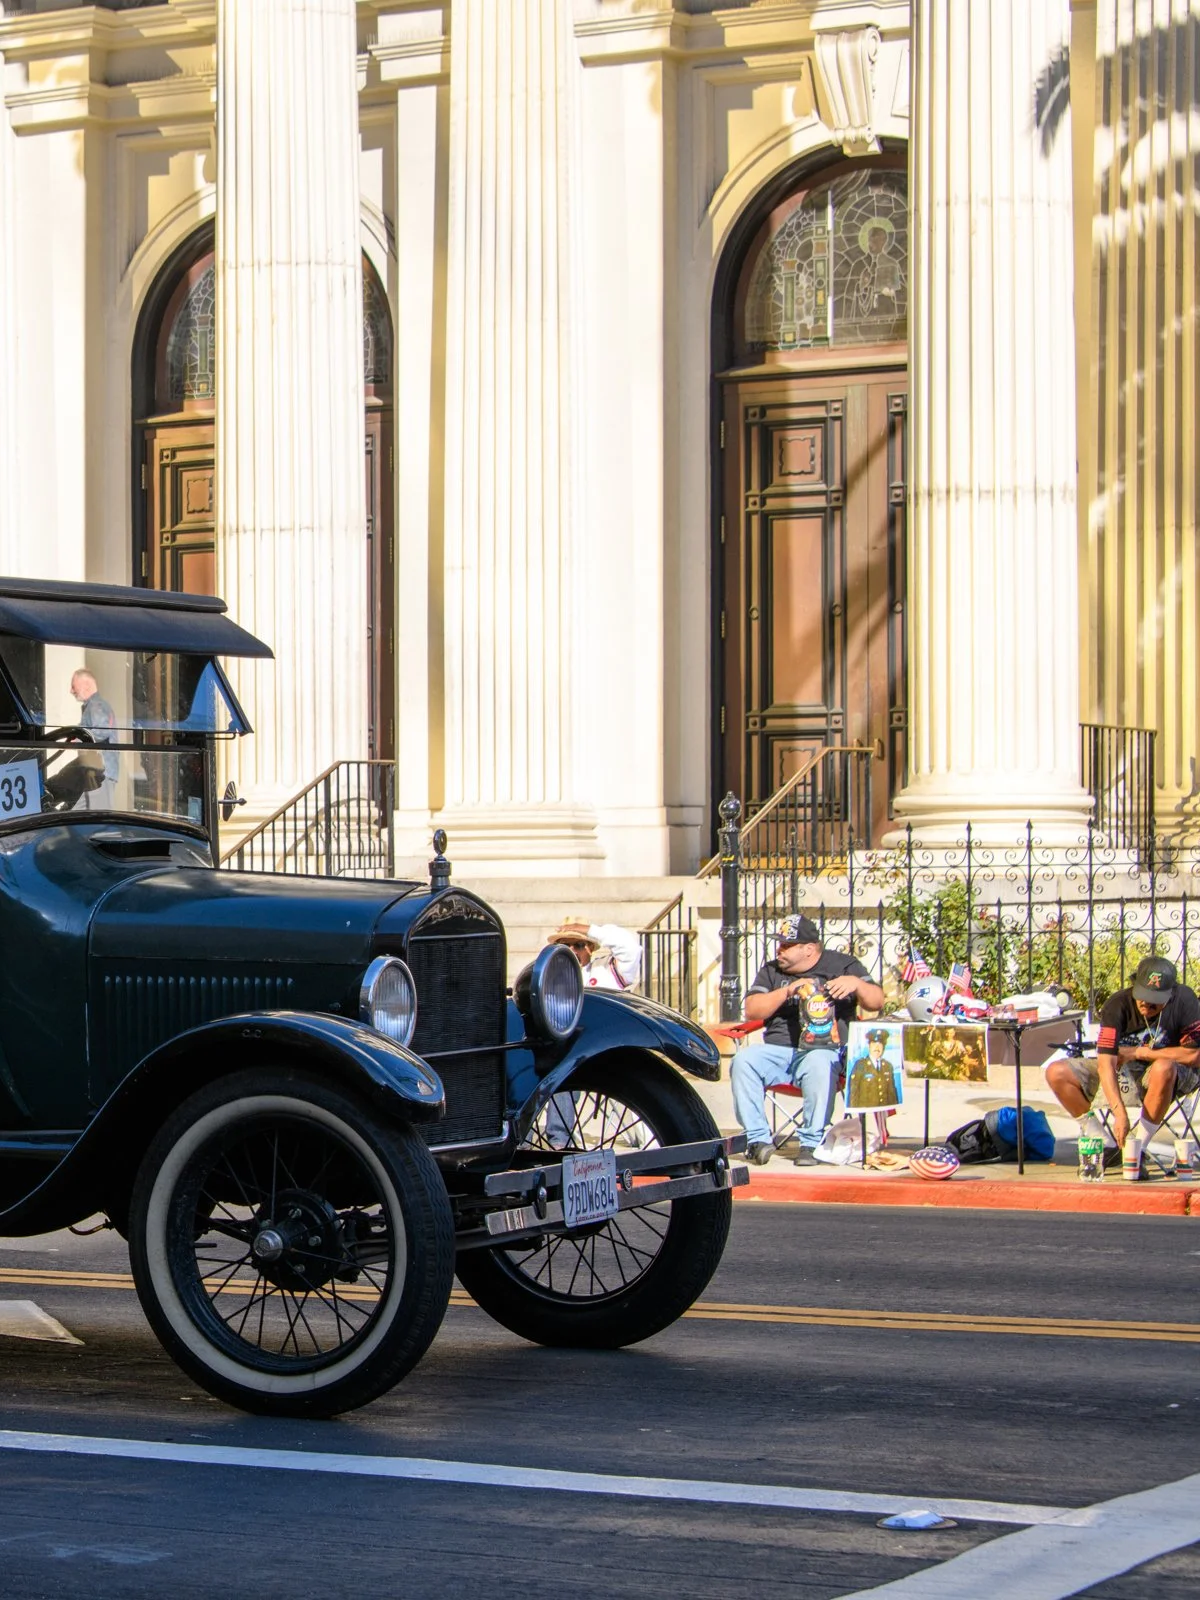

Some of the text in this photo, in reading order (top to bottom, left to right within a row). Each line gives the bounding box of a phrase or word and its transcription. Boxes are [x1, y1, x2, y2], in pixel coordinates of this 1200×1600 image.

[1, 775, 28, 812] 33
[573, 1159, 605, 1179] California
[567, 1176, 615, 1217] 9BDW684
